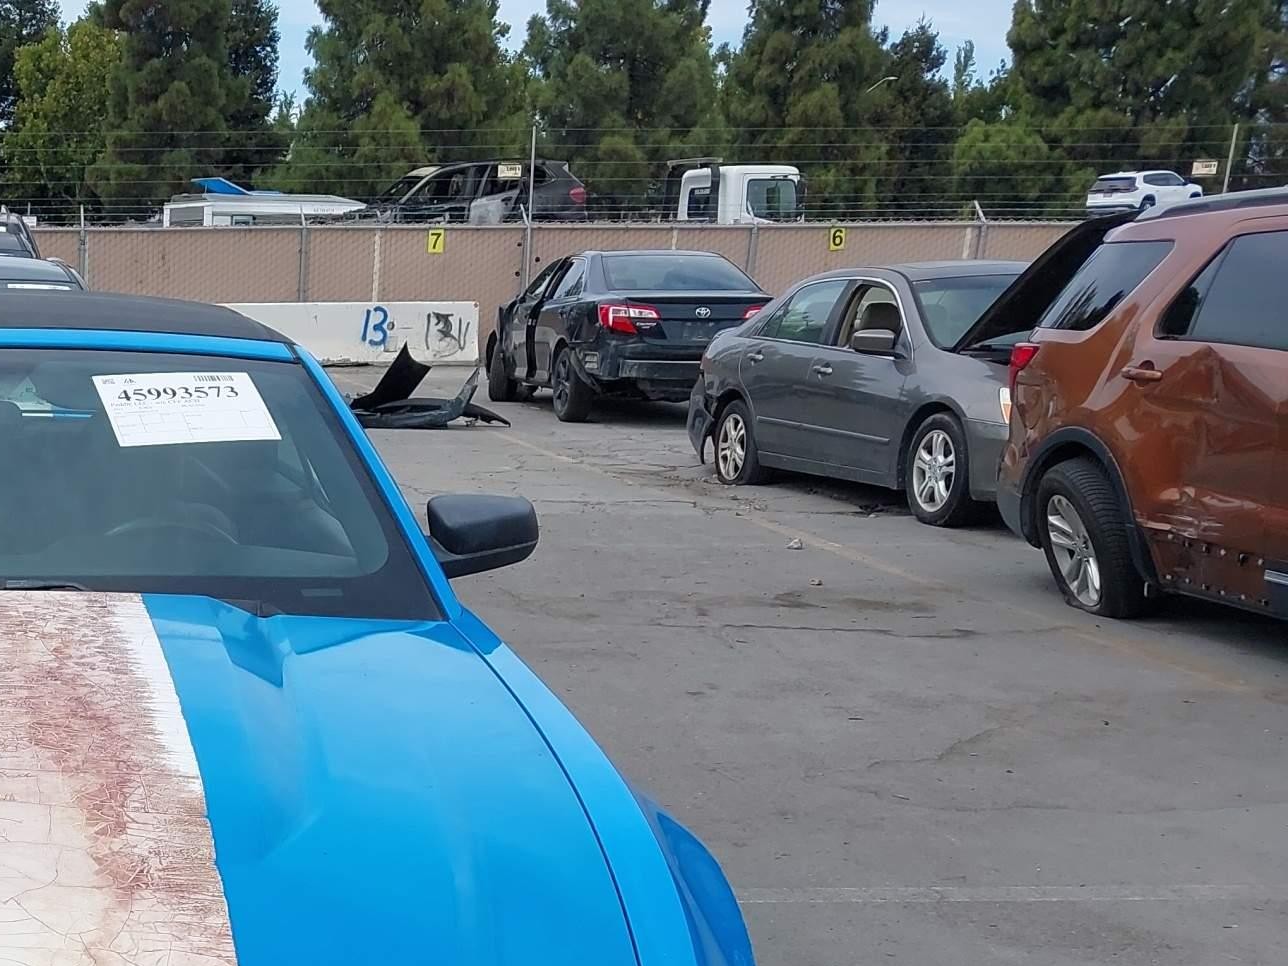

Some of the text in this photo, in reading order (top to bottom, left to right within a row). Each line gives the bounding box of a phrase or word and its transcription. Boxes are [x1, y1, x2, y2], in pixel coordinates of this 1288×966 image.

[430, 232, 442, 250] 7
[832, 229, 843, 247] 6
[117, 385, 239, 401] 45993573
